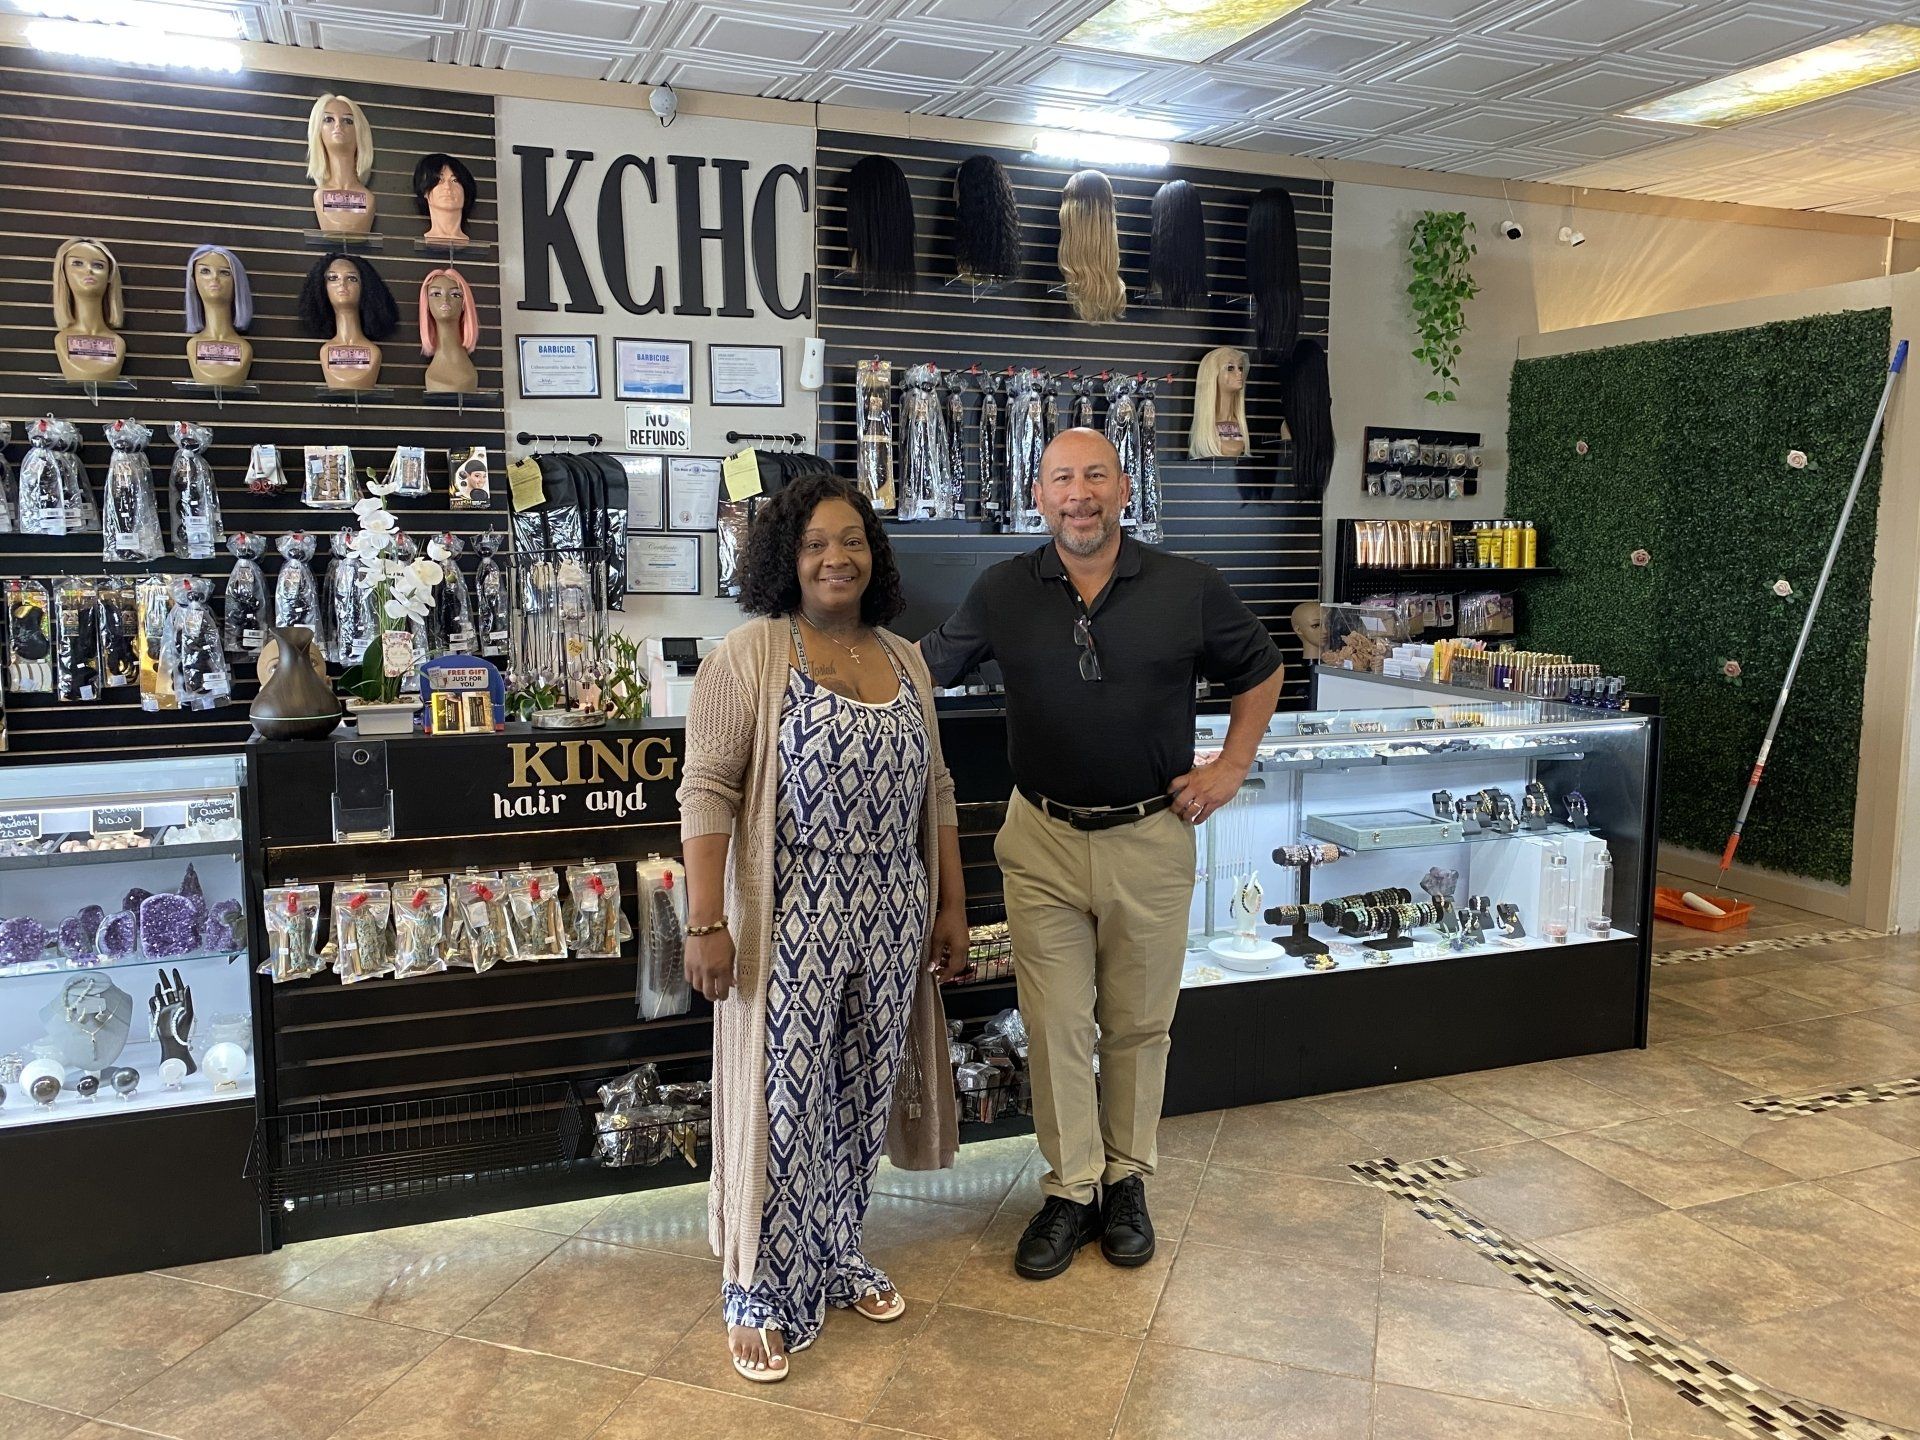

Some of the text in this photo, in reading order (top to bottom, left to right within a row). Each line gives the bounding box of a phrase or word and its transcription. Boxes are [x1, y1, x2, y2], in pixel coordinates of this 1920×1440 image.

[512, 145, 812, 320] KCHC
[538, 345, 576, 354] BARBICIDE
[636, 353, 670, 362] BARBICIDE
[645, 412, 670, 427] NO
[629, 429, 686, 446] REFUNDS
[506, 737, 678, 788] KING
[493, 782, 648, 819] hair and
[97, 815, 132, 825] $10.00
